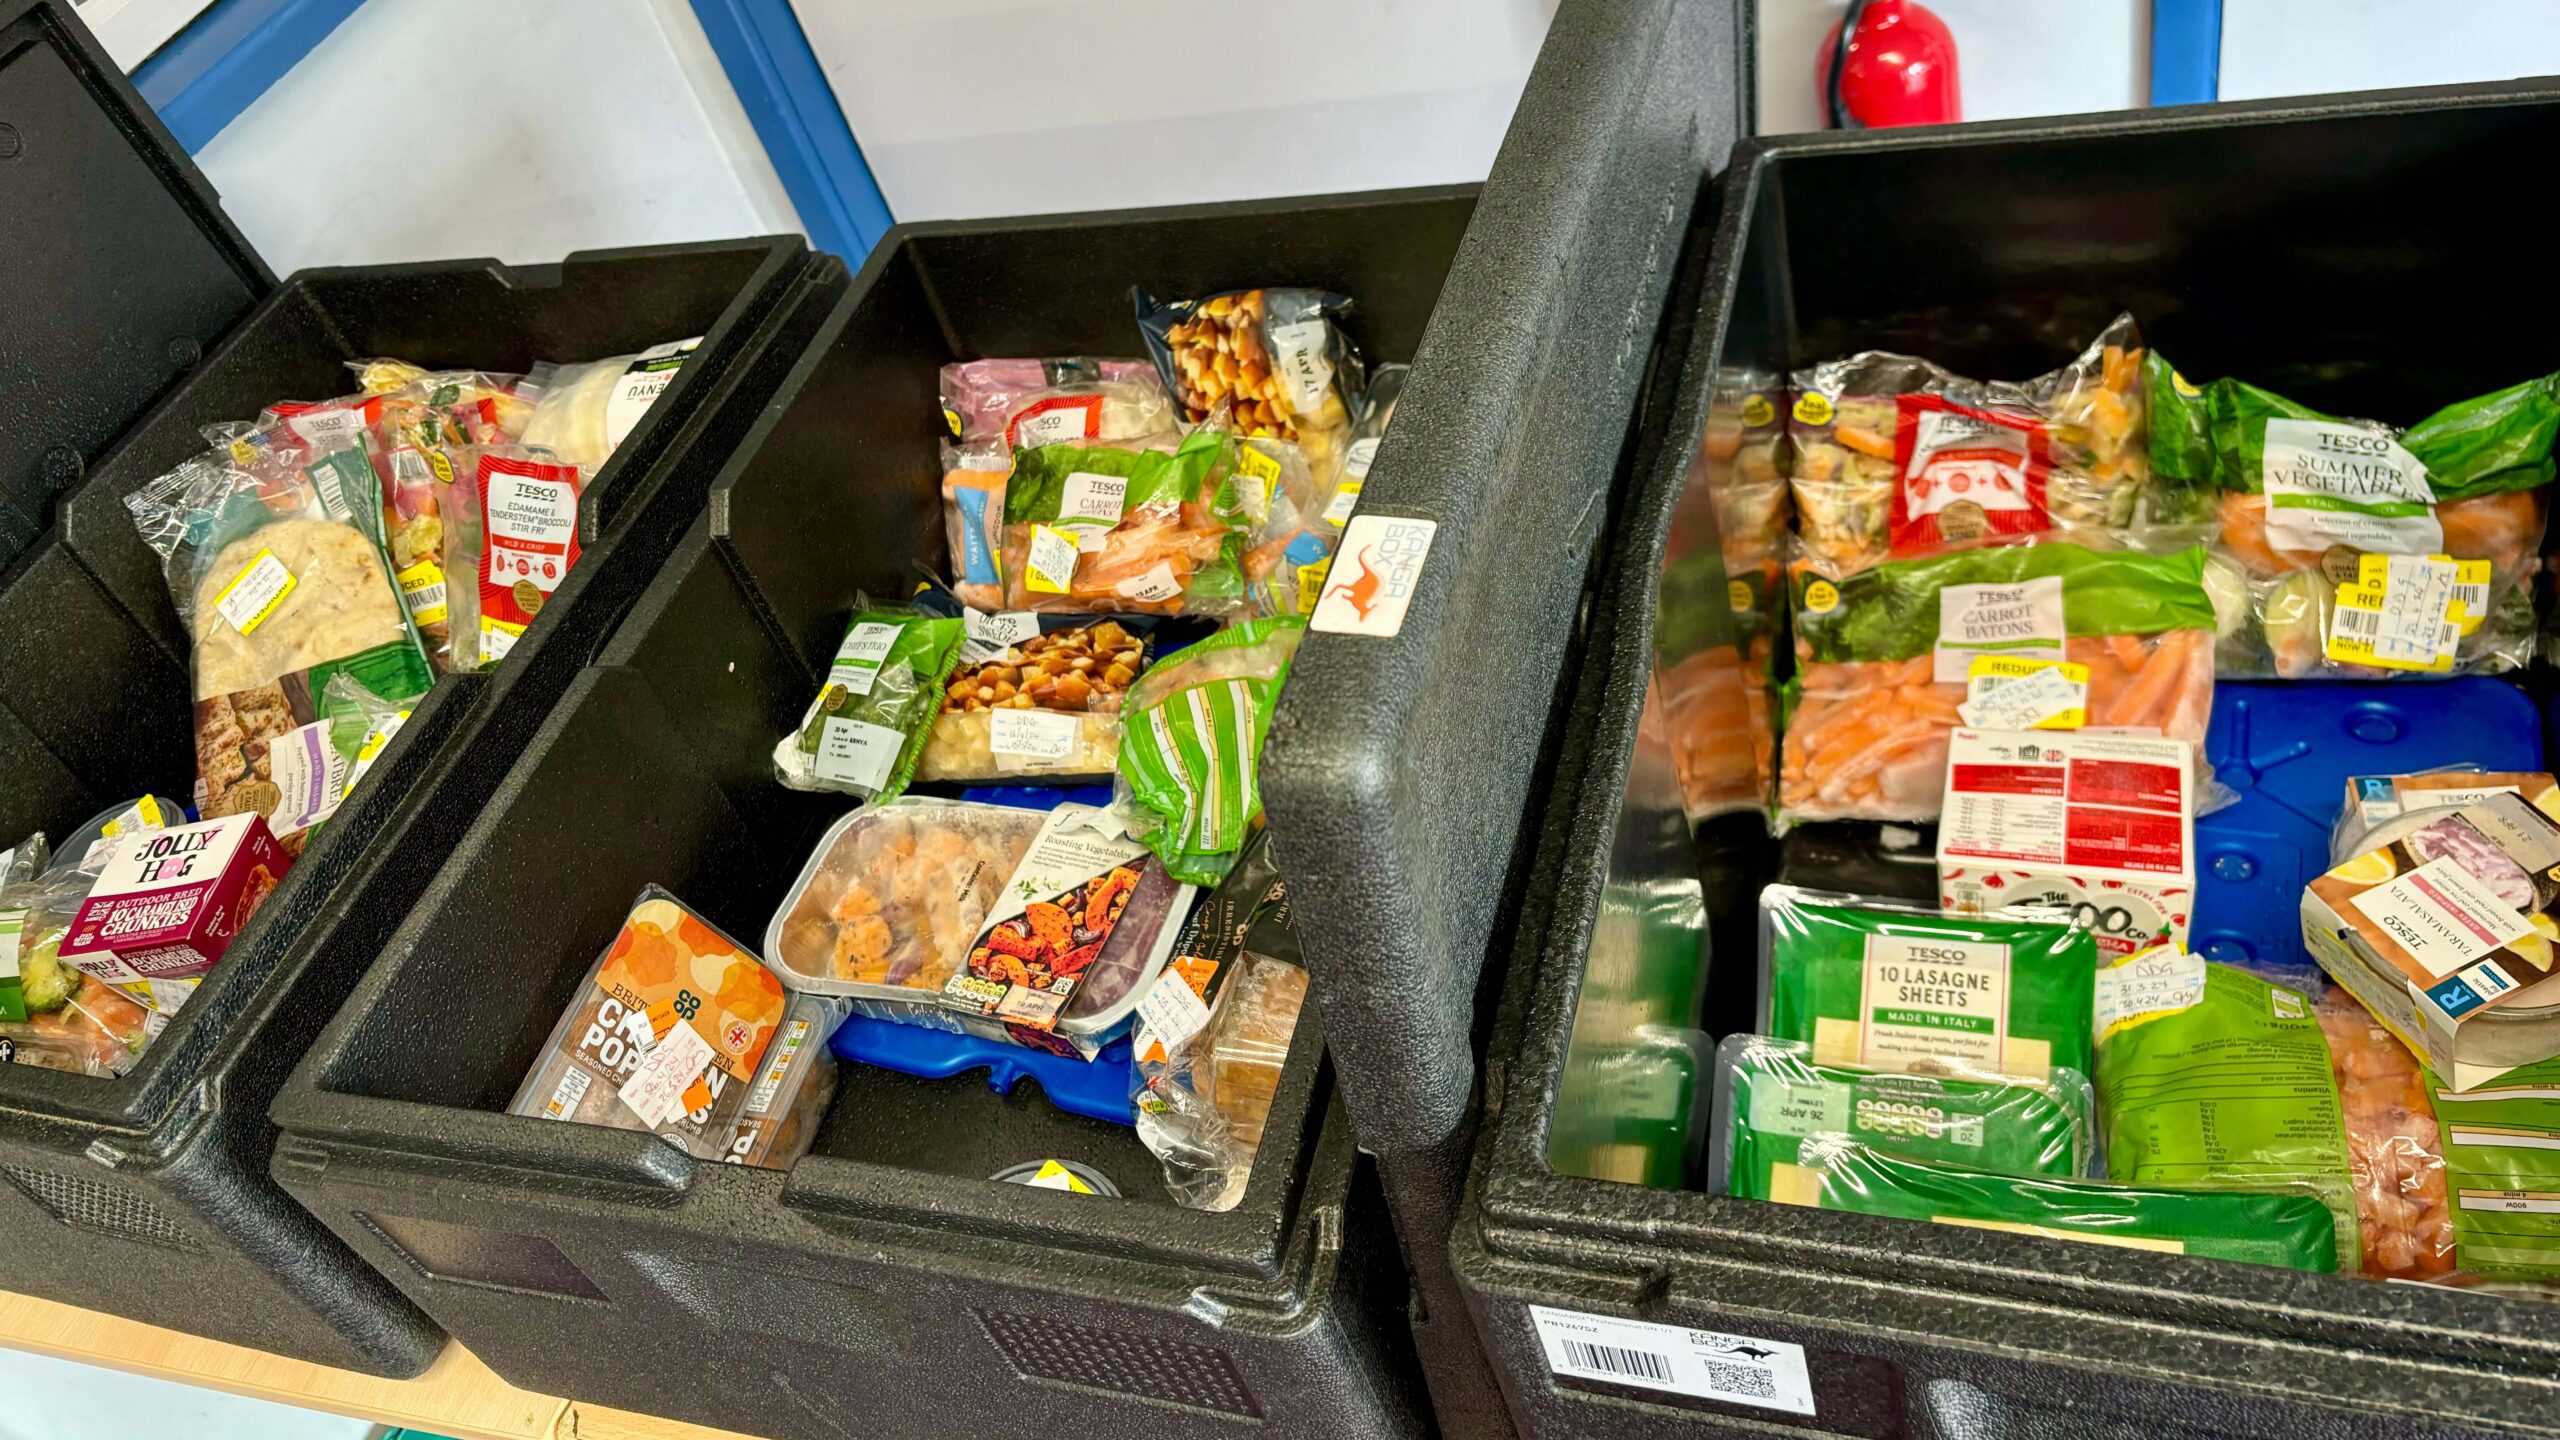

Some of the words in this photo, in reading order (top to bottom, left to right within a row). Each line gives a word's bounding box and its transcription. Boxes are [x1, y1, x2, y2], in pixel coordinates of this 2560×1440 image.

[1295, 347, 1314, 376] APR
[1039, 417, 1061, 426] SCO
[2318, 432, 2390, 452] TESCO
[2297, 454, 2402, 485] SUMMER
[516, 483, 558, 498] TESCO
[1090, 480, 1125, 492] TESCO
[507, 501, 550, 517] EDAMAME
[1080, 498, 1123, 510] CARROT
[511, 523, 529, 534] STIR
[531, 526, 546, 536] FRY
[537, 517, 571, 528] BROCCOLI
[1374, 523, 1408, 569] BOX
[1144, 585, 1159, 596] APR
[1963, 604, 2033, 624] CARROT
[1965, 620, 2034, 639] BATONS
[867, 642, 887, 651] TRIO
[135, 828, 223, 861] JOLLY
[1045, 834, 1084, 851] Roasting
[1086, 842, 1132, 860] Vegetables
[116, 893, 171, 909] OUTDOOR
[171, 887, 204, 900] BRED
[2041, 891, 2070, 902] THE
[2126, 887, 2150, 902] EXTRA
[106, 907, 129, 924] 10
[126, 896, 199, 922] CARAMELISED
[100, 909, 192, 937] CHUNKIES
[2390, 884, 2473, 957] TARAMASALATA
[2383, 916, 2422, 951] TESCO
[1907, 946, 1966, 961] TESCO
[136, 953, 208, 973] CHUNKIES
[1880, 966, 1899, 982] 10
[1904, 967, 1990, 991] LASAGNE
[2472, 977, 2495, 997] plastic
[1898, 985, 1968, 1007] SHEETS
[1027, 1002, 1045, 1011] APR
[1887, 1011, 1921, 1022] MADE
[1926, 1015, 1940, 1025] IN
[1943, 1016, 1978, 1029] ITALY
[574, 1048, 614, 1077] SEASONED
[2293, 1086, 2331, 1095] Vitamins
[1780, 1105, 1808, 1118] APR
[1810, 1109, 1824, 1121] 26
[2505, 1201, 2528, 1209] 900W
[1591, 1317, 1642, 1330] Professional
